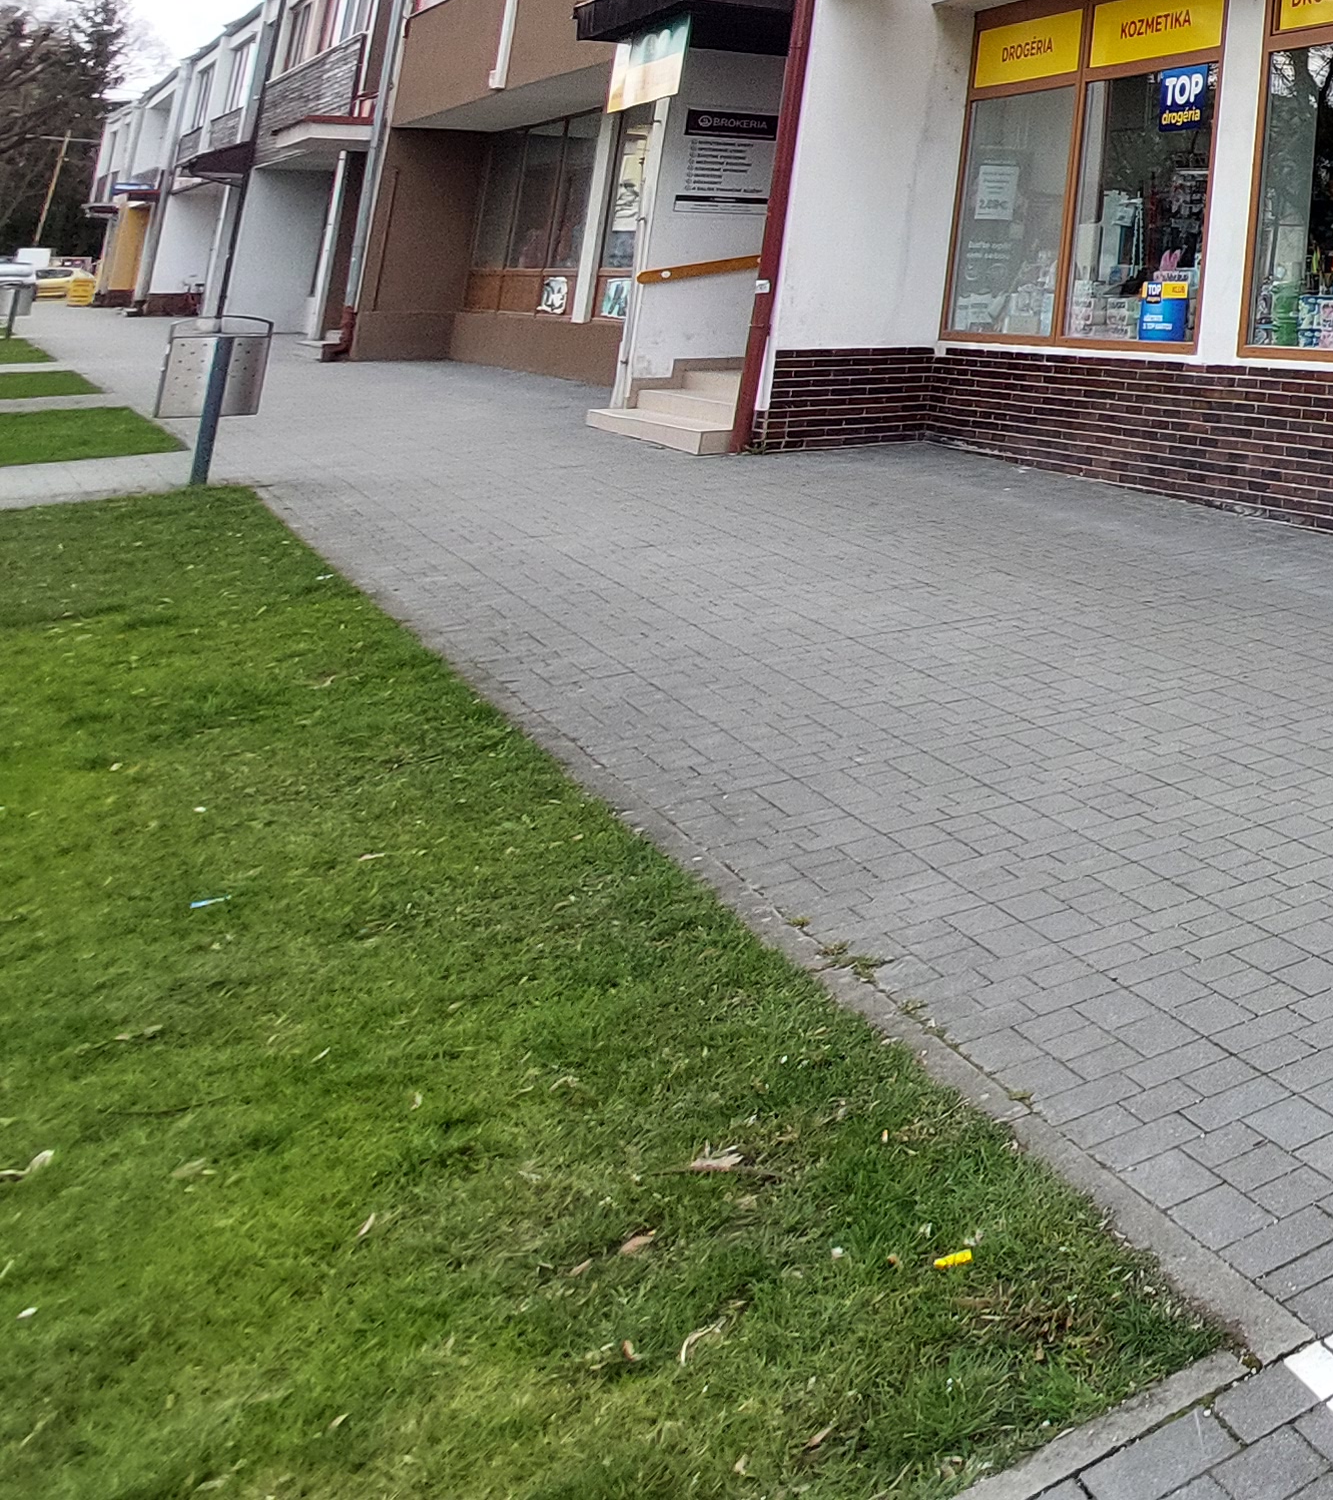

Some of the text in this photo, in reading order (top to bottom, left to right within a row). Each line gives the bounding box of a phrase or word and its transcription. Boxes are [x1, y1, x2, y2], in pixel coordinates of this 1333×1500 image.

[1120, 9, 1191, 39] KOZMETIKA
[1001, 36, 1053, 63] DROGÉRIA
[1165, 73, 1204, 106] TOP
[713, 117, 767, 129] BROKERIA
[1161, 107, 1200, 126] drogéria
[1148, 283, 1161, 296] TOP
